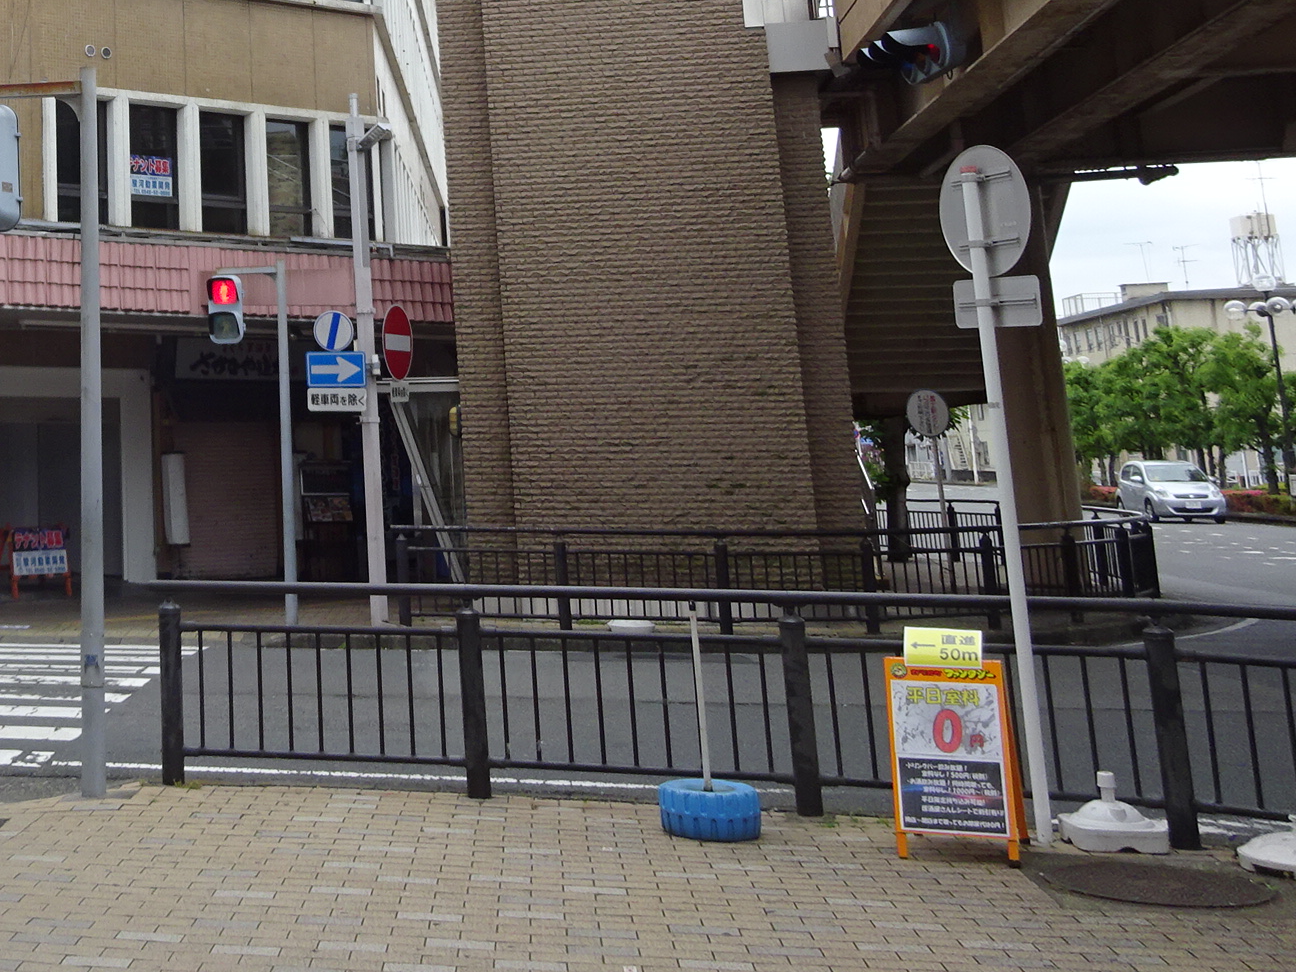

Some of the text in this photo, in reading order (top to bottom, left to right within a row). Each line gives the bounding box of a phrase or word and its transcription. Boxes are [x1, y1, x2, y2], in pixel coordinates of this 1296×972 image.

[311, 393, 365, 407] 軽車両を除く
[941, 633, 976, 647] 直進
[939, 648, 979, 662] 50m
[905, 686, 981, 708] 平日室料
